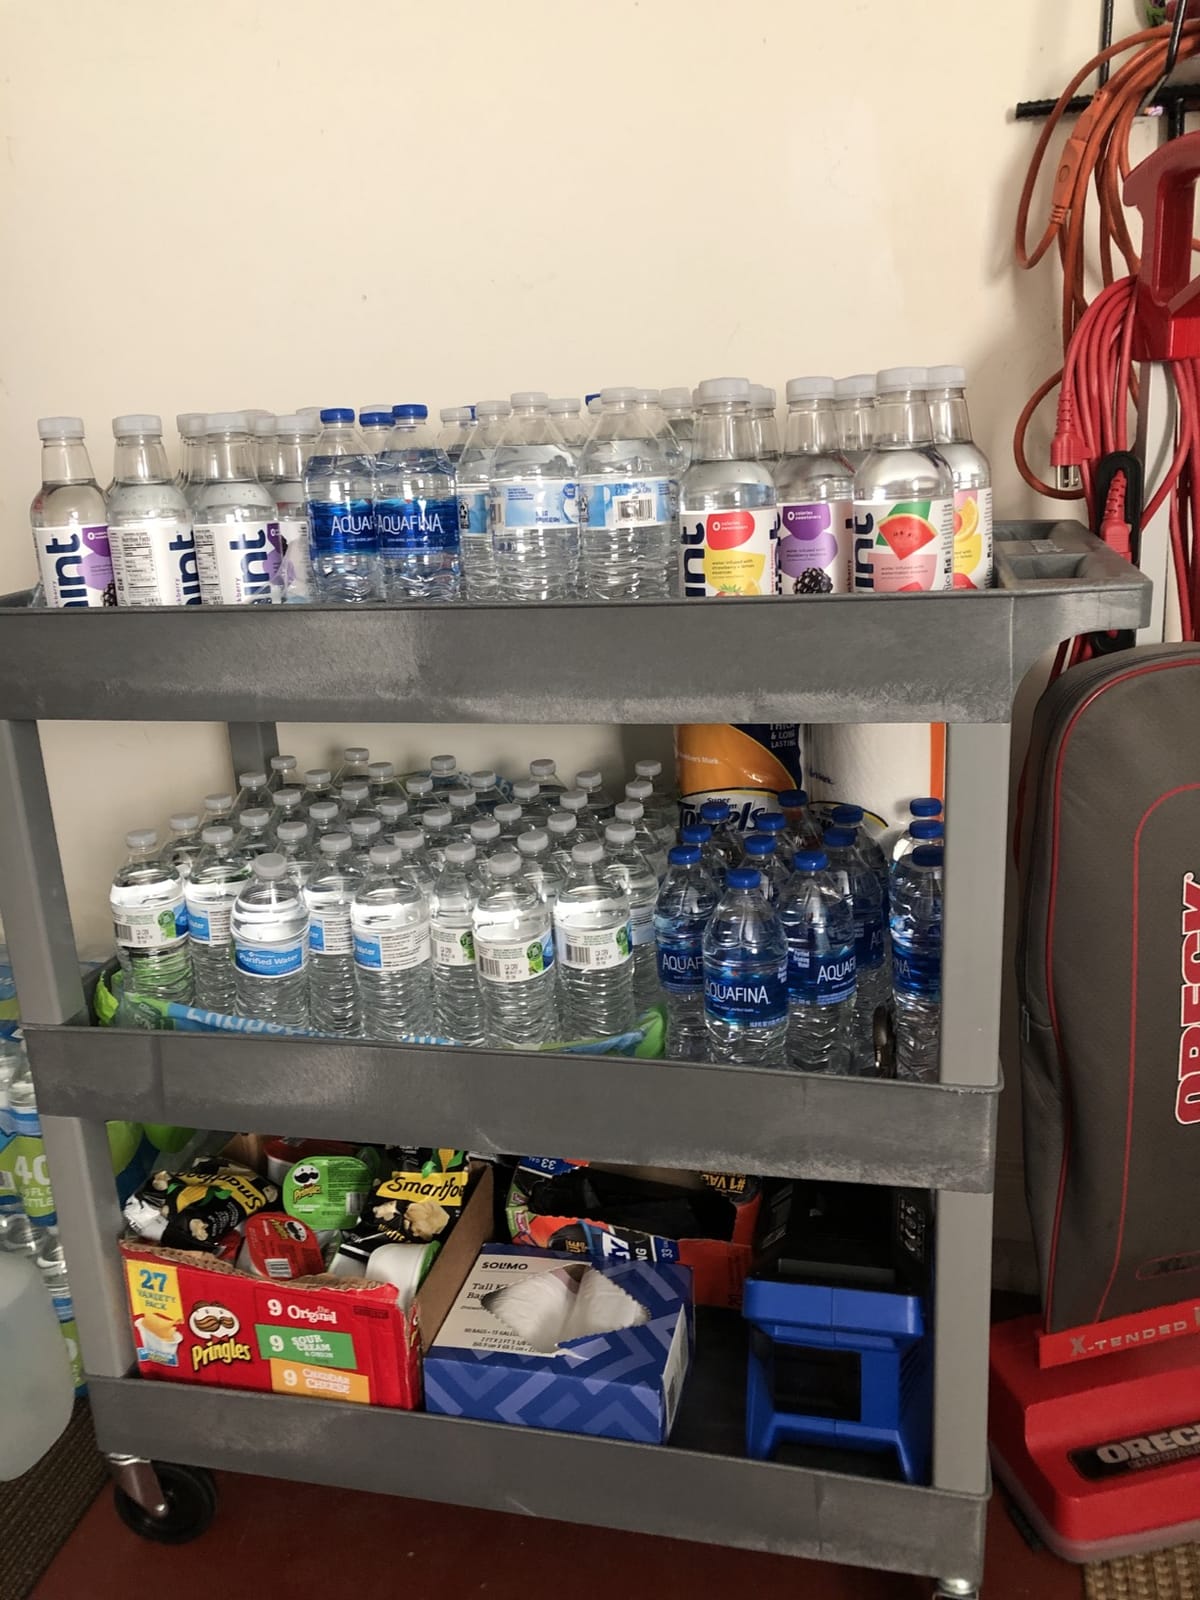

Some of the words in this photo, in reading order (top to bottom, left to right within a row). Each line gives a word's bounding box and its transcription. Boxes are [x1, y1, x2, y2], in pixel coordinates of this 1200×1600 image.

[229, 528, 272, 605] int
[239, 952, 272, 966] Purified
[273, 955, 298, 965] Water
[140, 1269, 168, 1293] 27
[472, 1283, 494, 1291] Tall
[137, 1289, 177, 1303] VARIETY
[144, 1299, 168, 1310] PACK
[267, 1298, 283, 1316] 9
[287, 1304, 338, 1324] Original
[269, 1335, 284, 1352] 9
[191, 1337, 252, 1371] Pringles
[282, 1368, 298, 1387] 9
[1096, 1424, 1200, 1464] OREC
